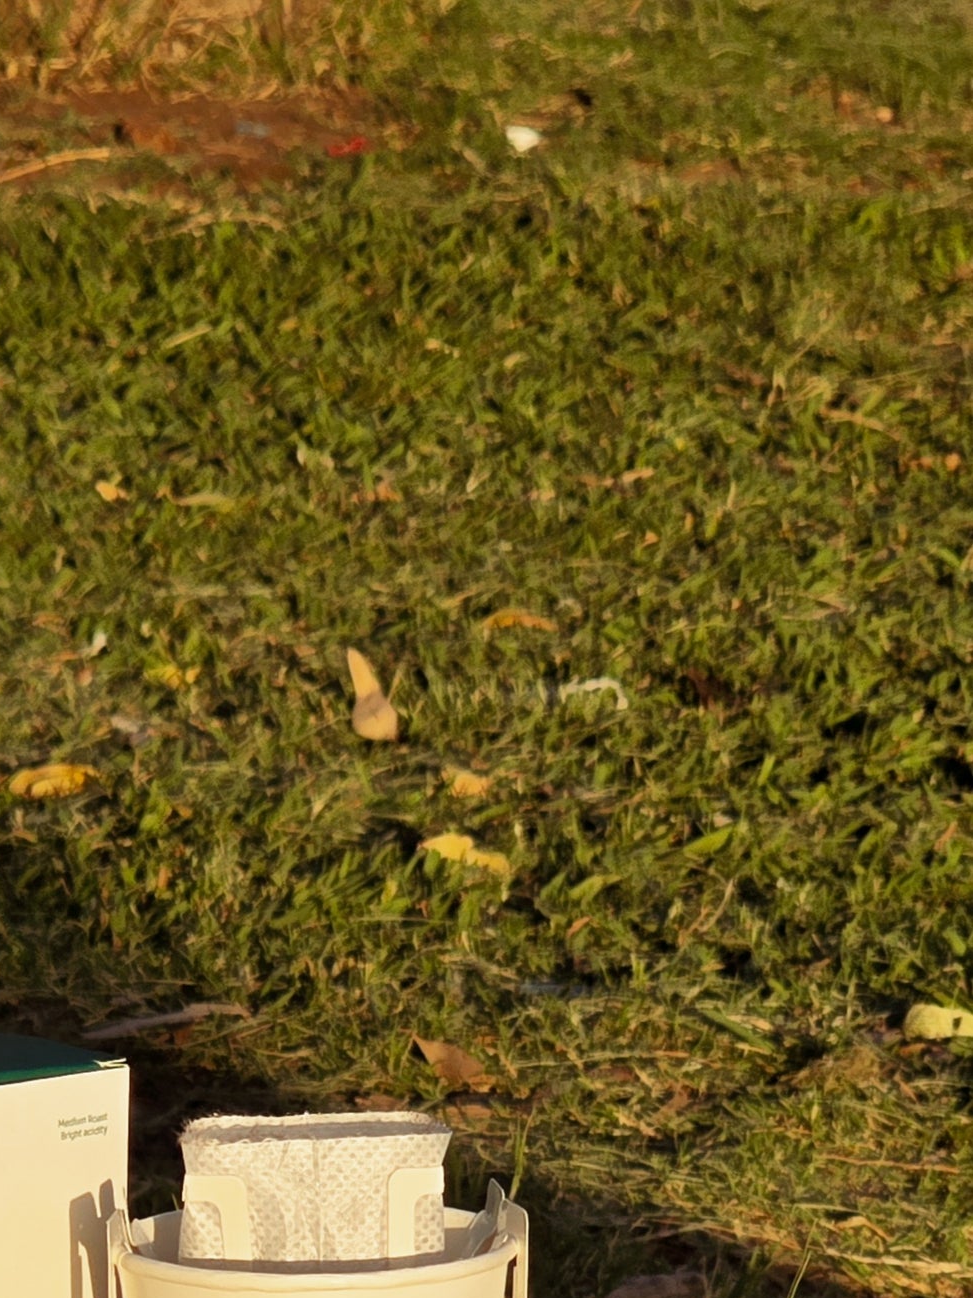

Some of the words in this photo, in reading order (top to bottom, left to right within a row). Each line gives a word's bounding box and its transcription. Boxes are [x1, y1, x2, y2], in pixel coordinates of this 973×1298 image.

[88, 1113, 107, 1123] Roast
[61, 1129, 82, 1141] Bright
[83, 1126, 107, 1136] acidity
